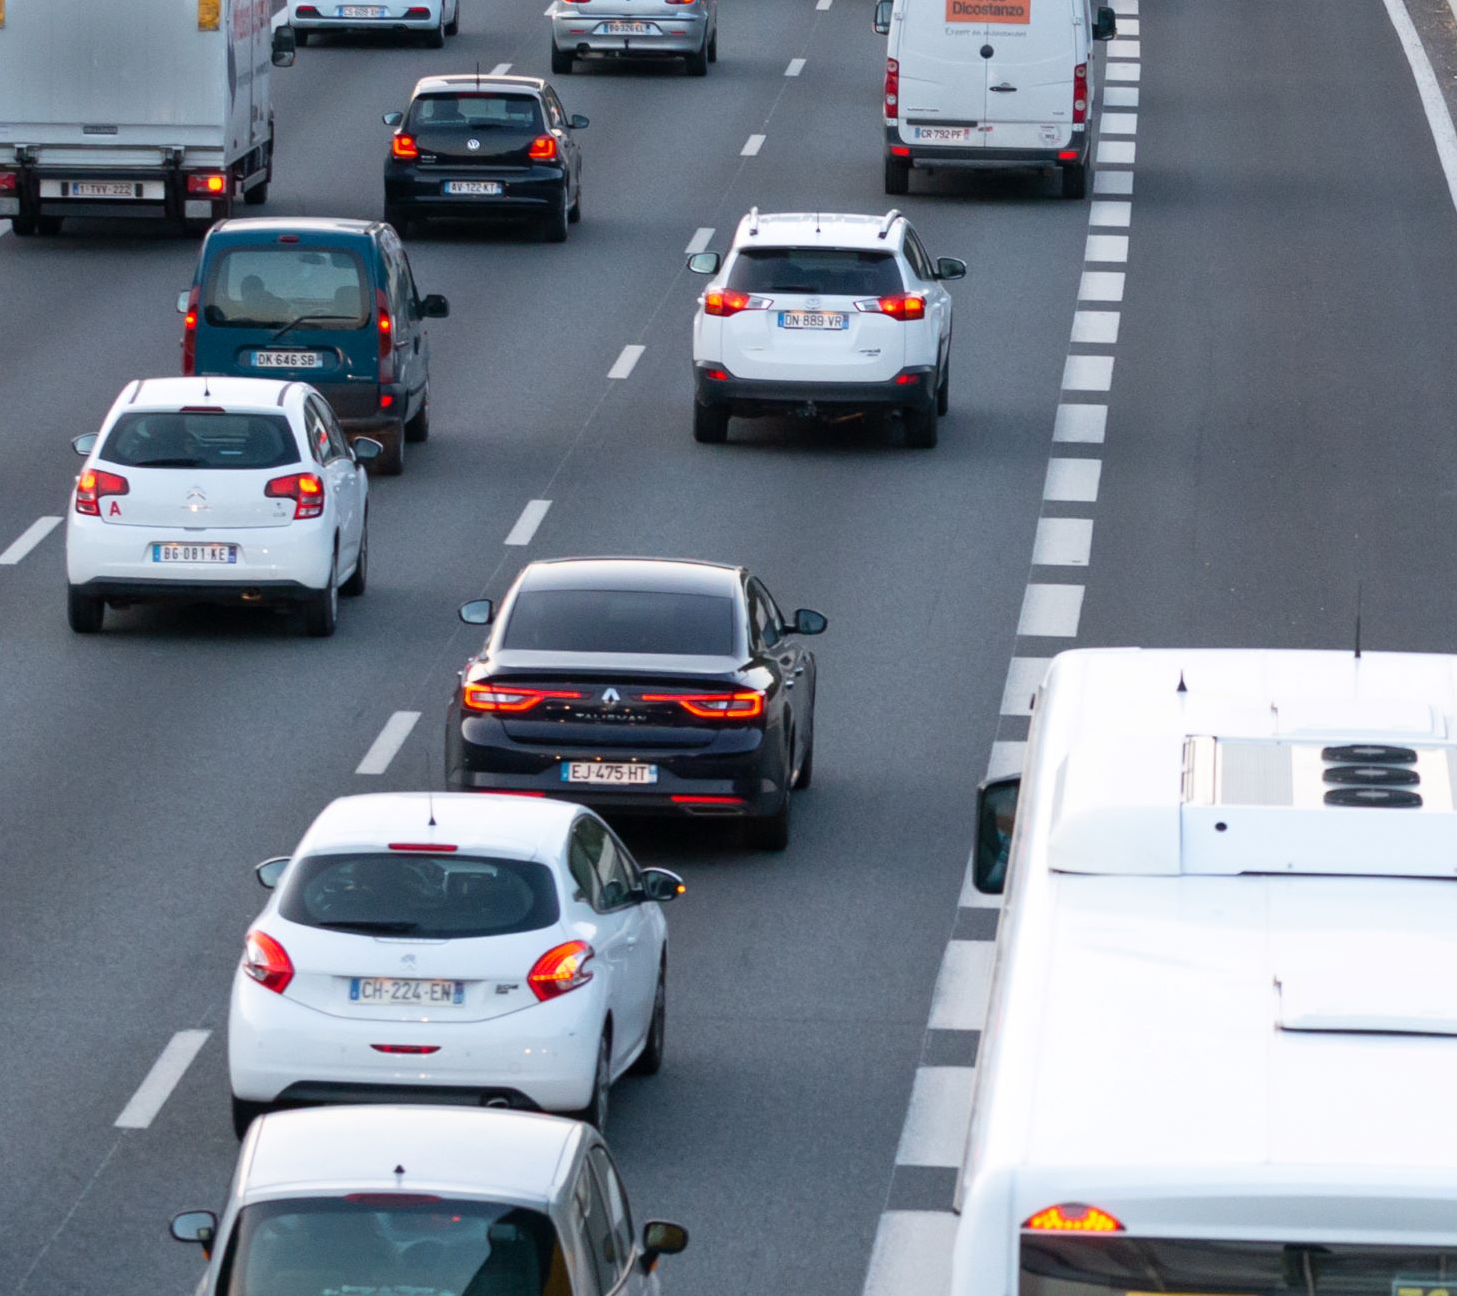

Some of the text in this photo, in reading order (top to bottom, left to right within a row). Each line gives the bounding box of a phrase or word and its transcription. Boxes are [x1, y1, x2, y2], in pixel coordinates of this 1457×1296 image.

[952, 2, 1024, 17] Dicostanzo
[109, 502, 121, 516] A
[571, 765, 648, 782] EJ-475-HT
